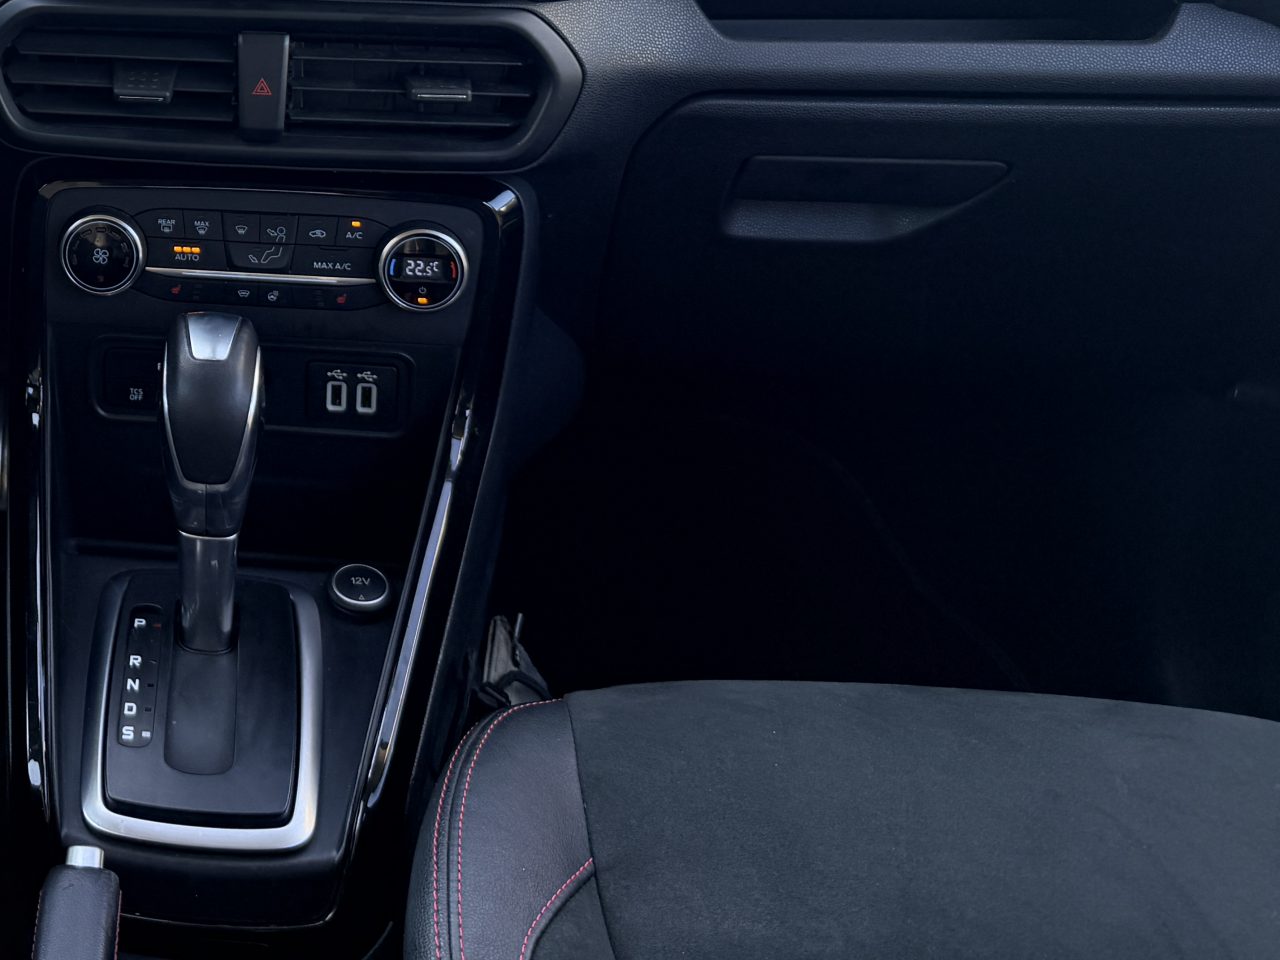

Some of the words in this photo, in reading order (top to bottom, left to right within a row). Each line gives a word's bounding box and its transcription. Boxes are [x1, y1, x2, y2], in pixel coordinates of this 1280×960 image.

[345, 231, 363, 239] A/C
[174, 253, 200, 261] AUTO
[313, 261, 333, 269] MAX
[334, 262, 351, 270] A/C
[129, 387, 143, 395] TCS
[350, 576, 370, 585] 12V
[133, 618, 147, 628] P
[129, 654, 142, 667] R
[126, 678, 140, 691] N
[123, 702, 137, 715] D
[121, 725, 135, 740] S
